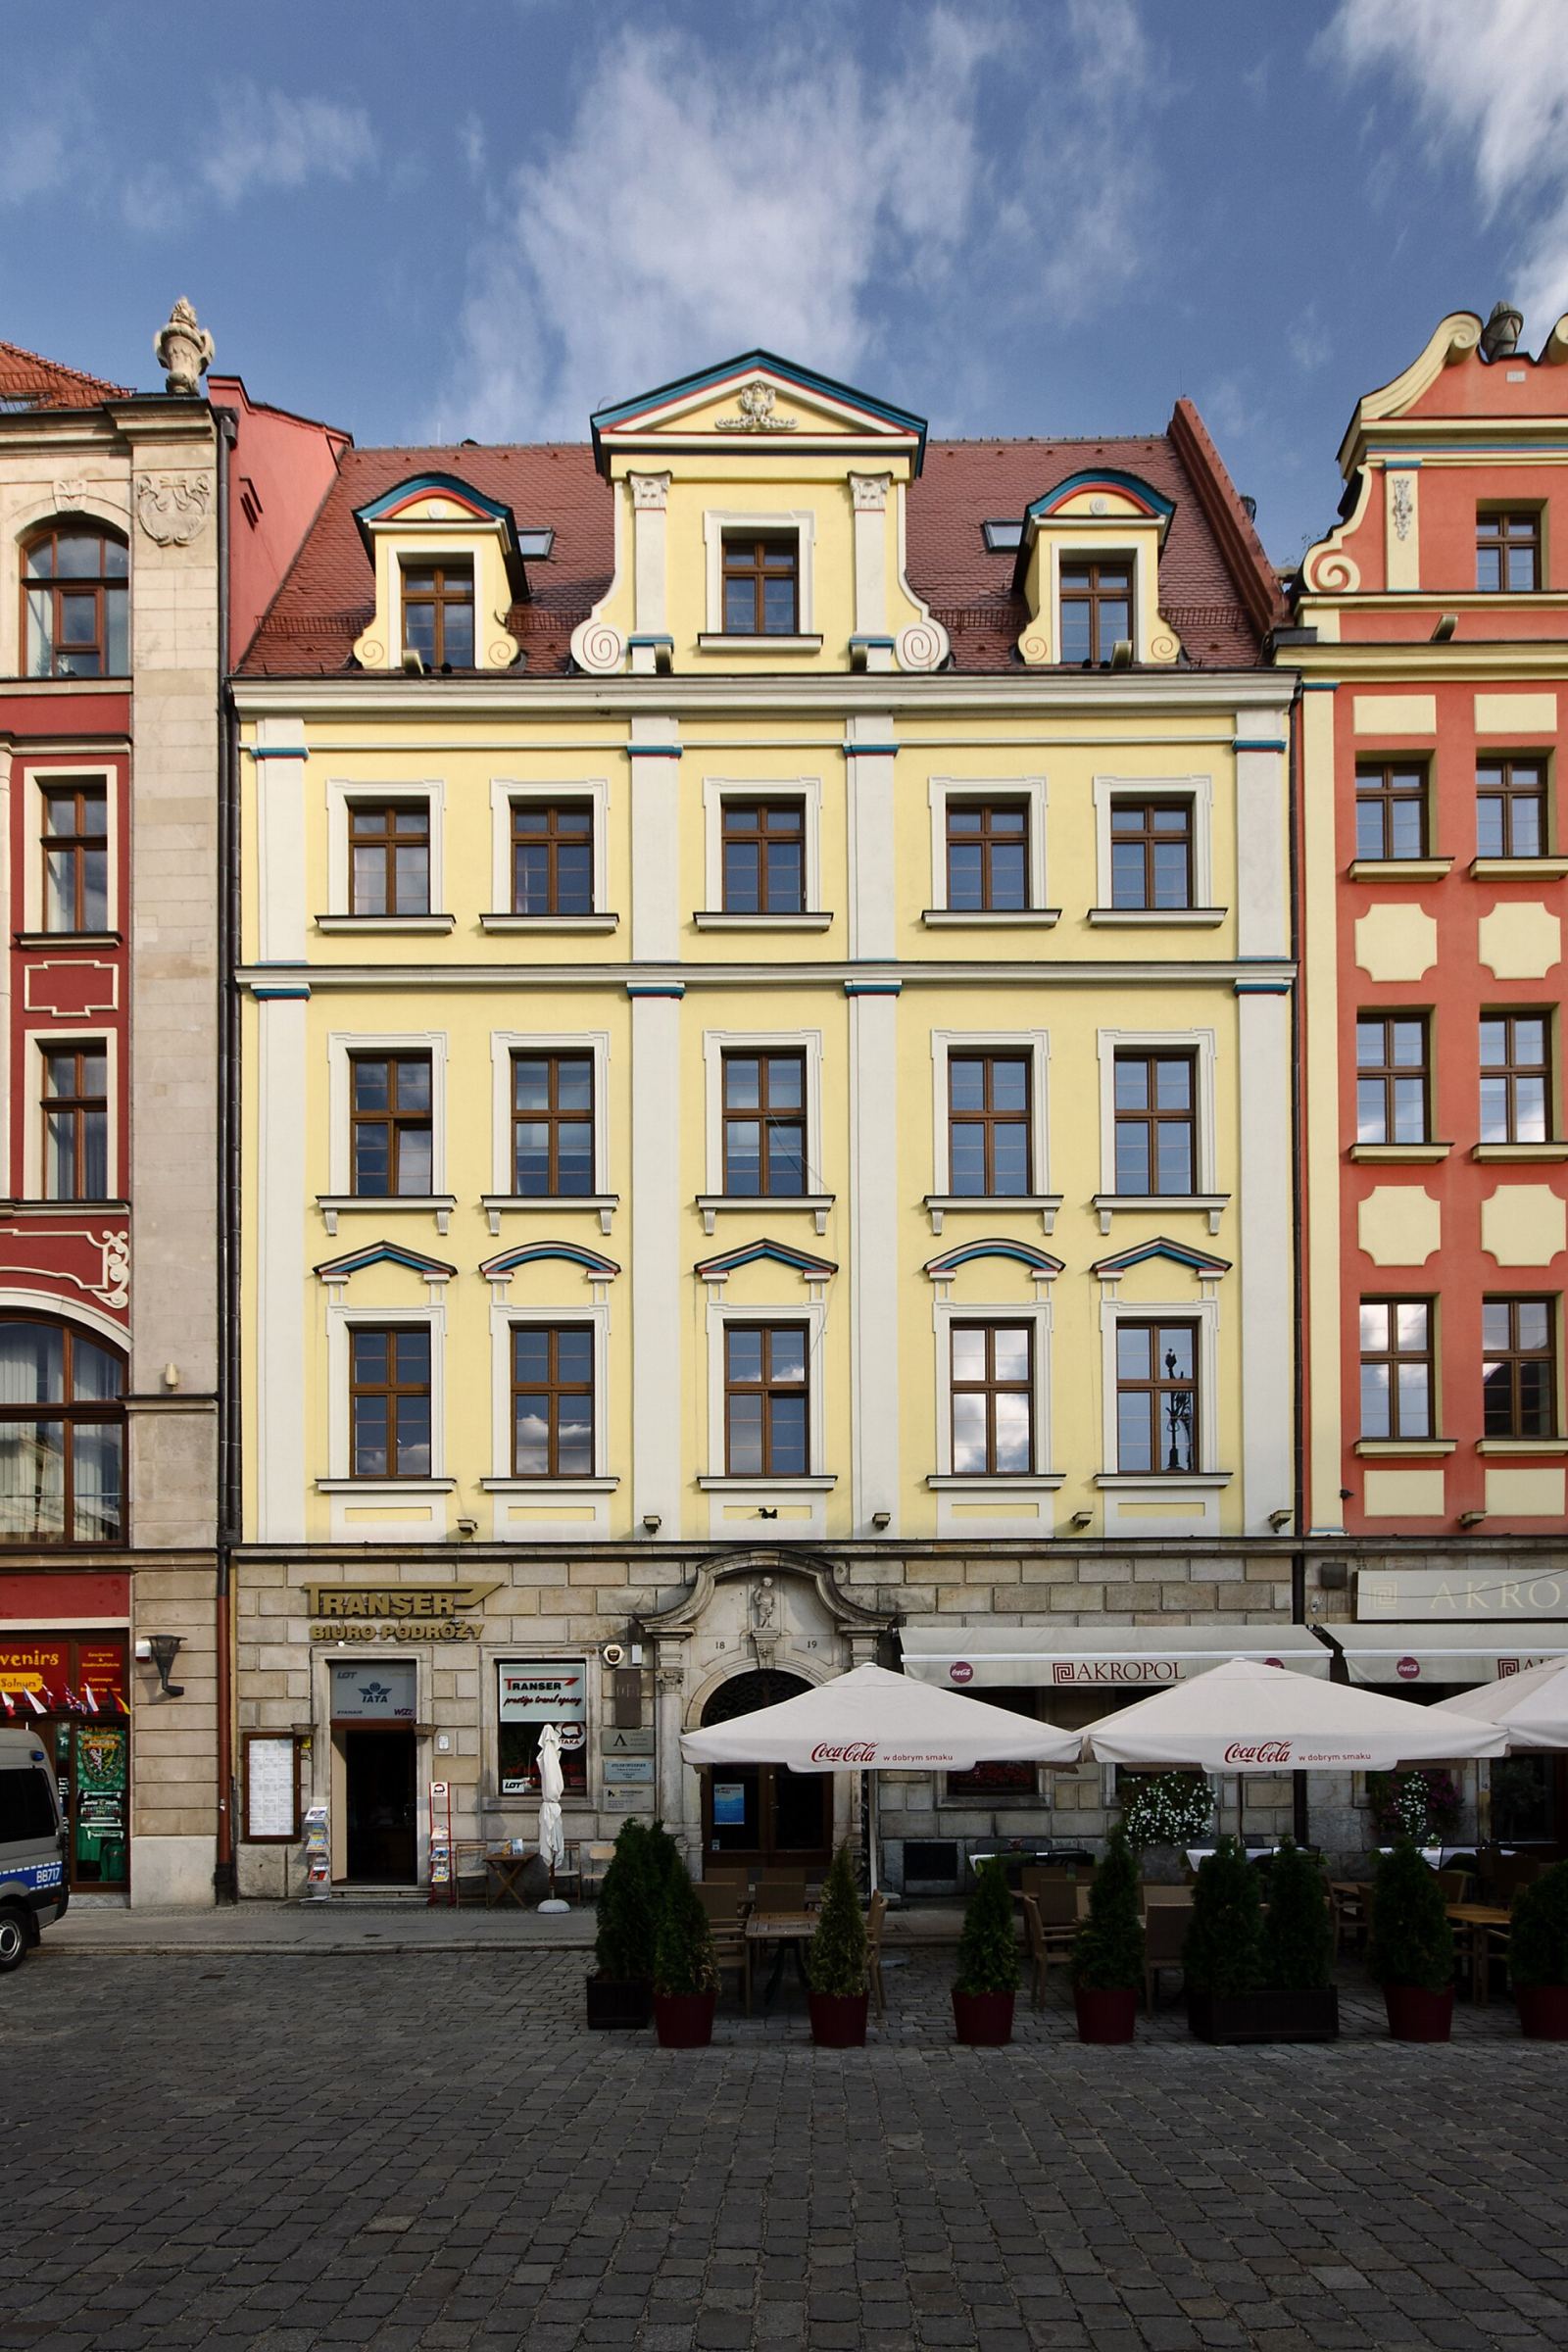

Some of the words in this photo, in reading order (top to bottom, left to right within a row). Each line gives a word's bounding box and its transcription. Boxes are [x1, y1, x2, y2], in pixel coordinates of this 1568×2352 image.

[304, 1582, 504, 1616] TRANSER
[1431, 1580, 1568, 1609] AKRO
[311, 1624, 376, 1641] BIURO
[380, 1619, 484, 1641] PODRÓŻY
[715, 1641, 725, 1649] 18
[807, 1640, 817, 1648] 19
[0, 1650, 59, 1666] venirs
[1077, 1662, 1186, 1681] AKROPOL
[504, 1677, 580, 1690] TRANSER
[811, 1742, 879, 1763] Coca-Cola
[893, 1754, 923, 1763] dobrym
[1225, 1740, 1294, 1764] Coca-Cola
[1308, 1753, 1341, 1763] dobrym
[1343, 1752, 1372, 1761] smaku
[36, 1867, 60, 1883] BB717
